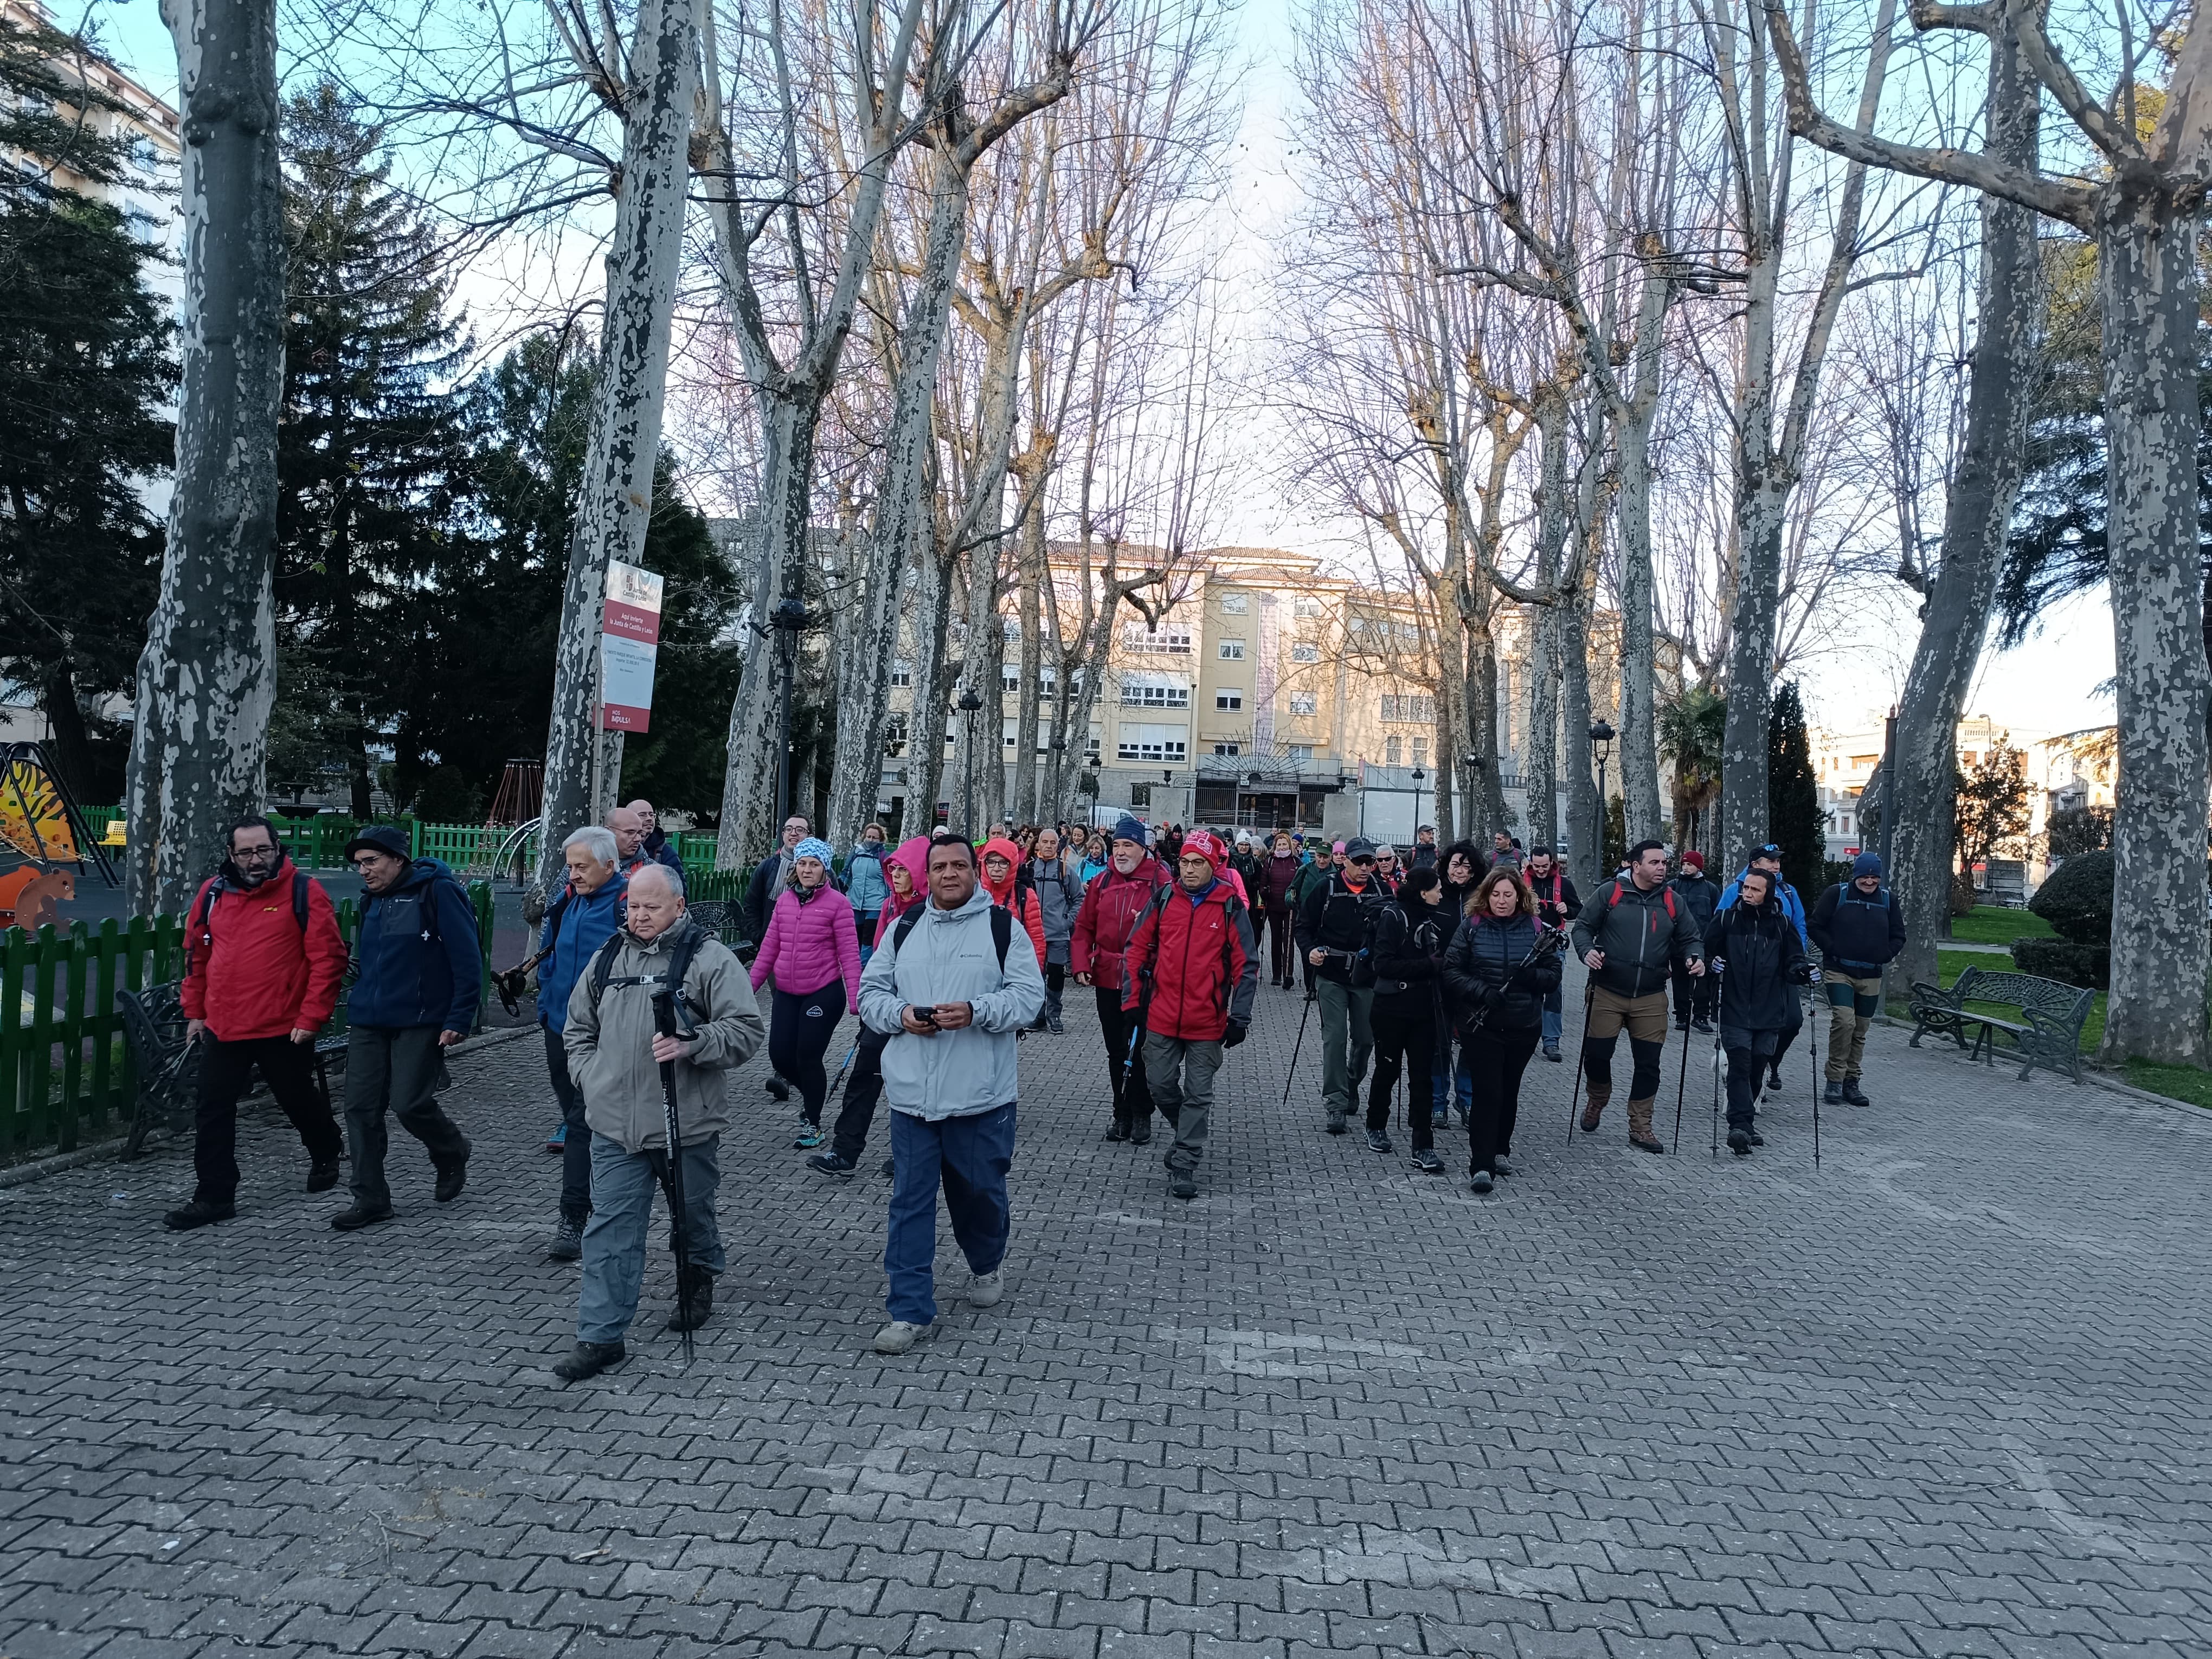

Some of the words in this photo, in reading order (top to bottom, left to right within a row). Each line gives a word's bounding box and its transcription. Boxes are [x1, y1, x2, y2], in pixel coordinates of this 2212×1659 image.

[622, 590, 635, 599] Castilla
[621, 613, 630, 621] Aquí
[630, 615, 644, 624] invierte
[629, 623, 641, 632] Castilla
[611, 716, 631, 724] IMPULSA
